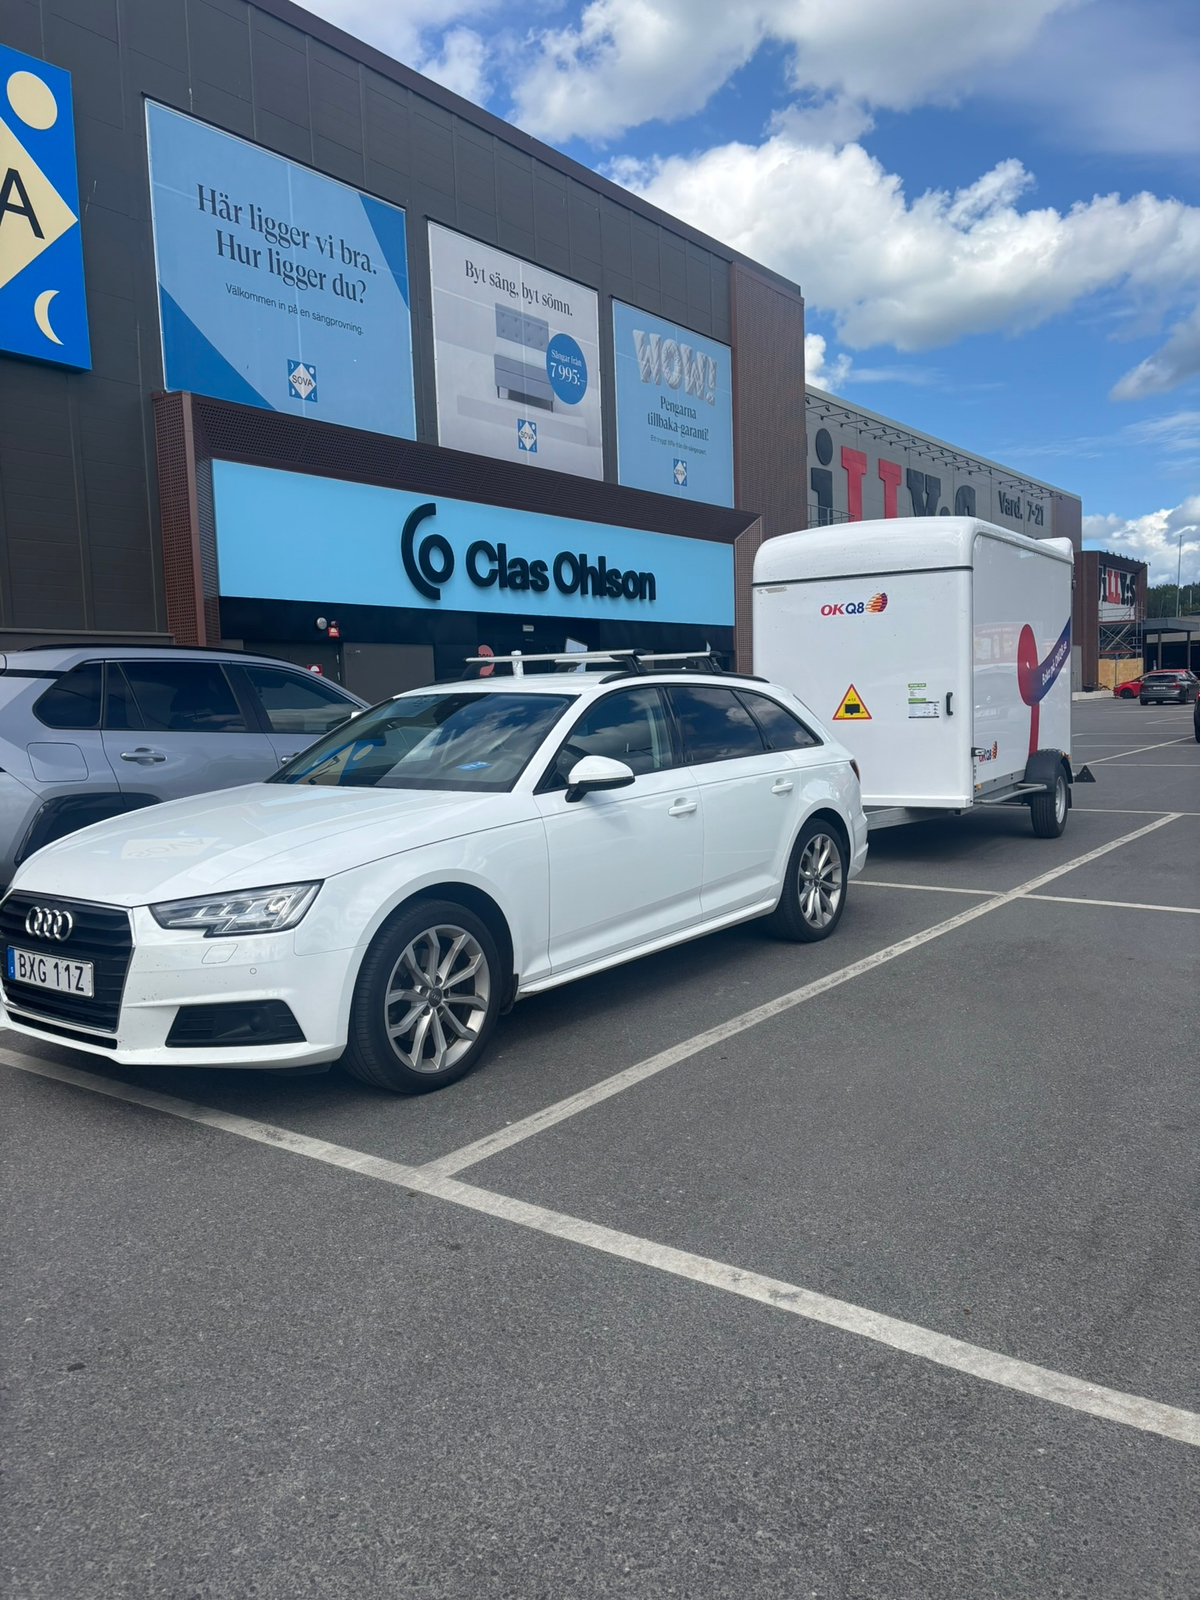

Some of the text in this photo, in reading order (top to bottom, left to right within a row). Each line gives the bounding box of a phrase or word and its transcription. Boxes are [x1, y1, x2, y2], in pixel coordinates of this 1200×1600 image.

[197, 183, 377, 275] Här ligger vi bra.
[216, 229, 367, 304] Hur ligger du?
[465, 260, 573, 316] Byt säng, byt sömn.
[225, 282, 364, 336] Välkommen in på en sängprovning.
[291, 374, 314, 388] SOVA
[632, 329, 717, 406] WOW!
[647, 412, 709, 441] tillbaka-garanti!
[660, 395, 697, 420] Pengarna
[998, 490, 1044, 526] Vard. 7-21
[465, 540, 657, 601] Clas Ohlson
[820, 602, 865, 617] OKQ8
[19, 954, 85, 992] BXG 11Z
